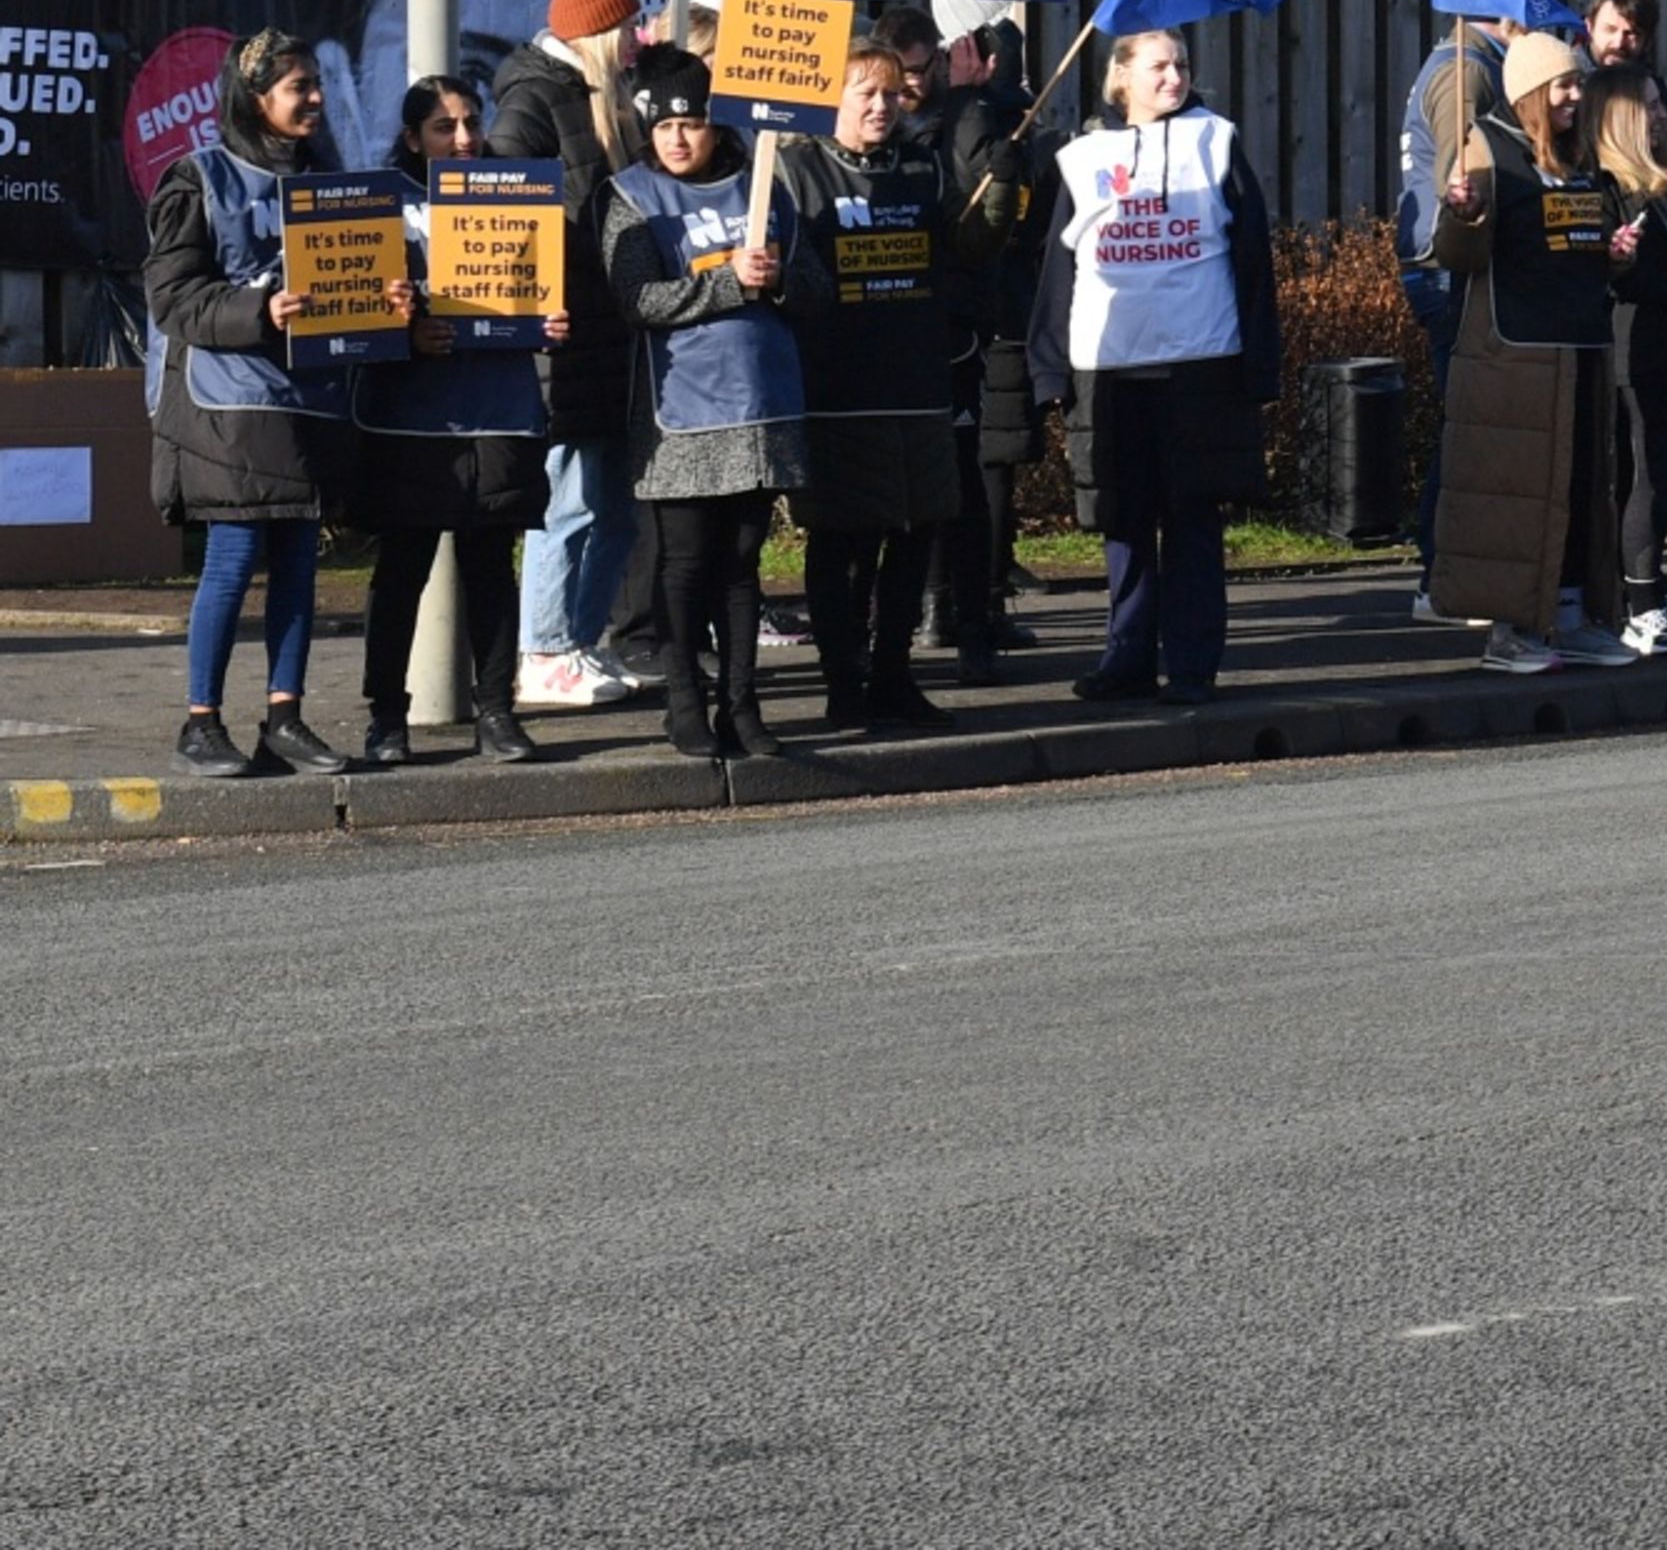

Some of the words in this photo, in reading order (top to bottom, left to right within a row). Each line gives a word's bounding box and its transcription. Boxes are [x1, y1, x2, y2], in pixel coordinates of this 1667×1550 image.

[744, 0, 777, 16] It's
[781, 3, 829, 23] time
[752, 22, 773, 39] to
[778, 28, 816, 46] pay
[741, 44, 821, 69] nursing
[725, 64, 774, 82] staff
[779, 69, 832, 92] fairly
[468, 172, 499, 183] FAIR
[500, 172, 527, 183] PAY
[317, 188, 344, 199] FAIR
[345, 185, 369, 198] PAY
[468, 184, 494, 194] FOR
[497, 183, 555, 195] NURSING
[343, 195, 395, 209] NURSING
[1118, 196, 1166, 217] THE
[454, 216, 485, 232] It's
[491, 215, 539, 232] time
[1167, 218, 1201, 237] OF
[305, 232, 334, 250] It's
[339, 229, 384, 247] time
[464, 240, 485, 253] to
[492, 242, 529, 258] pay
[1096, 240, 1202, 263] NURSING
[316, 257, 336, 271] to
[341, 254, 376, 273] pay
[456, 260, 536, 279] nursing
[310, 275, 384, 295] nursing
[442, 282, 491, 298] staff
[495, 282, 550, 300] fairly
[348, 297, 396, 315] fairly
